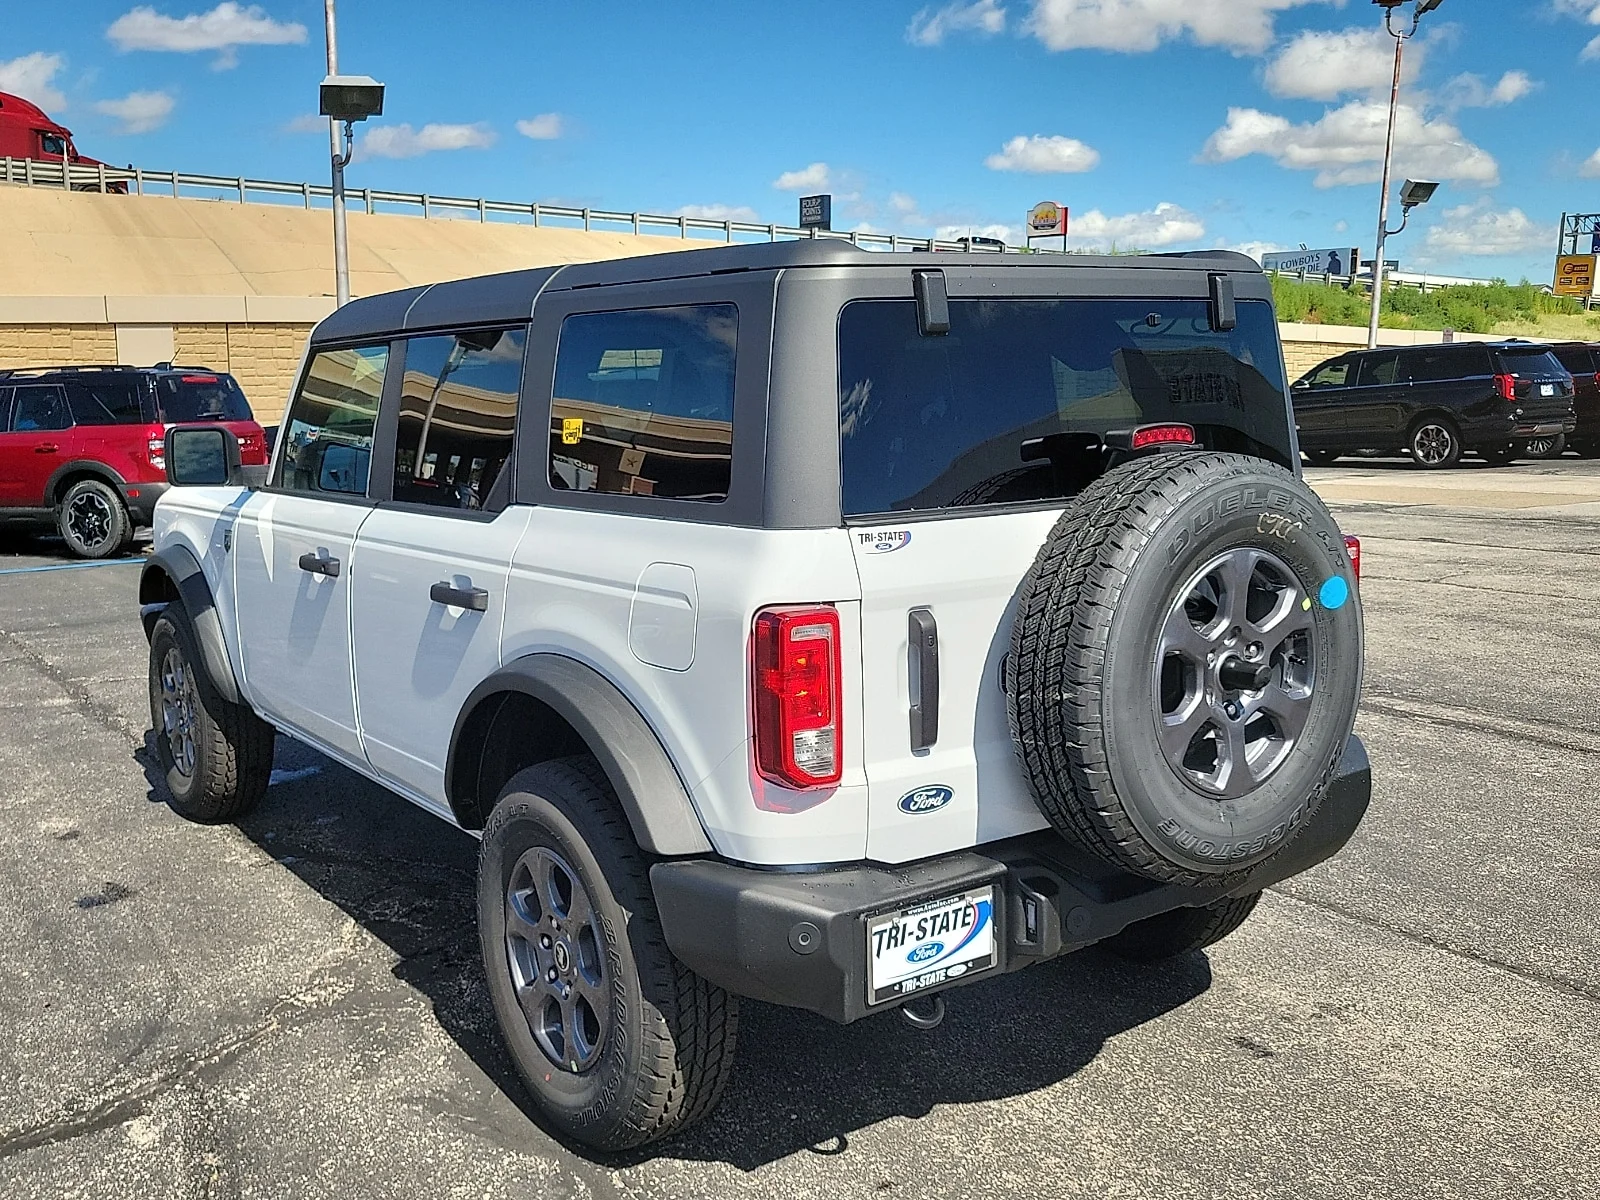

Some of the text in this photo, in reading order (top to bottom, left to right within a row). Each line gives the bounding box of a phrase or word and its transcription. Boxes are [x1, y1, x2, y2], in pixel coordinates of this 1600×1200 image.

[1280, 252, 1320, 270] COWBOYS
[1307, 262, 1321, 273] DIE
[1164, 487, 1314, 566] DUELER
[858, 531, 904, 545] TRI-STATE
[909, 789, 946, 811] Ford
[872, 903, 972, 960] TRI-STATE
[912, 943, 939, 960] Ford
[901, 967, 947, 994] TRI-STATE
